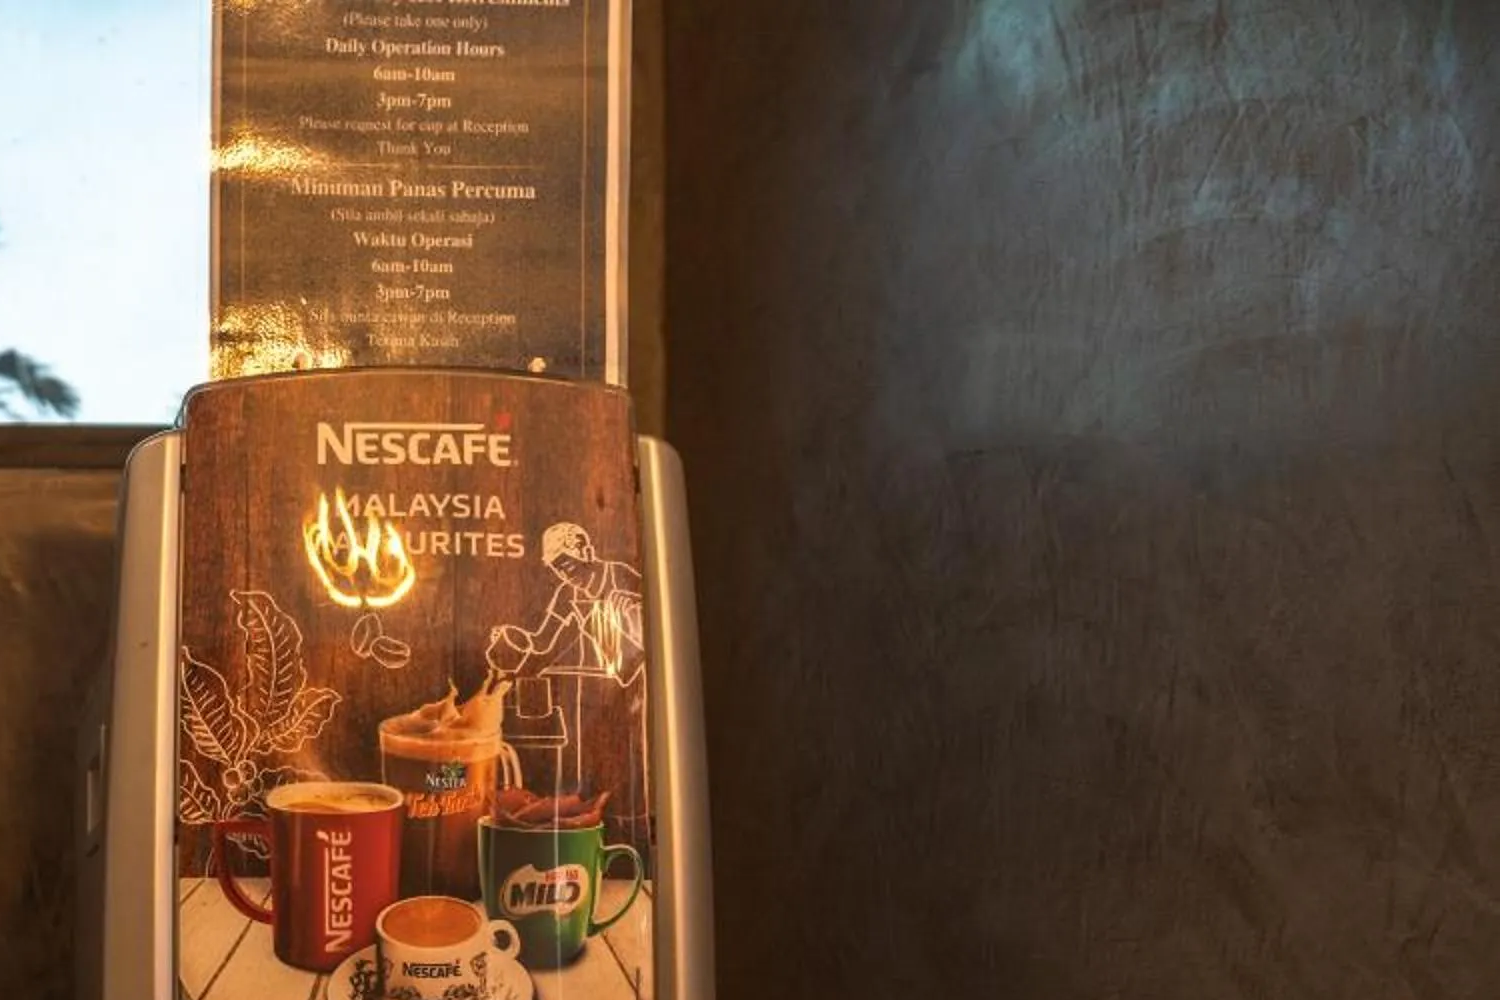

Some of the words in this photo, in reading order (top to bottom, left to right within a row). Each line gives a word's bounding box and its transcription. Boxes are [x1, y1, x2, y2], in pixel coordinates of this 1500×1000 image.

[325, 37, 366, 56] Daily
[372, 39, 451, 58] Operation
[455, 41, 505, 56] Hours
[373, 67, 455, 82] 6am-10am
[377, 92, 451, 111] 3pm-7pm
[463, 119, 529, 138] Reception
[376, 140, 417, 155] Thank
[423, 141, 451, 155] You
[291, 178, 383, 197] Minuman
[389, 180, 446, 198] Panas
[452, 181, 536, 200] Percuma
[353, 231, 406, 248] Waktu
[411, 232, 473, 250] Operasi
[372, 259, 453, 274] 6am-10am
[376, 284, 450, 302] 3pm-7pm
[448, 311, 516, 327] Reception
[335, 492, 506, 520] MALAYSIA
[316, 831, 353, 953] NESCAFÉ
[509, 881, 581, 908] MILO
